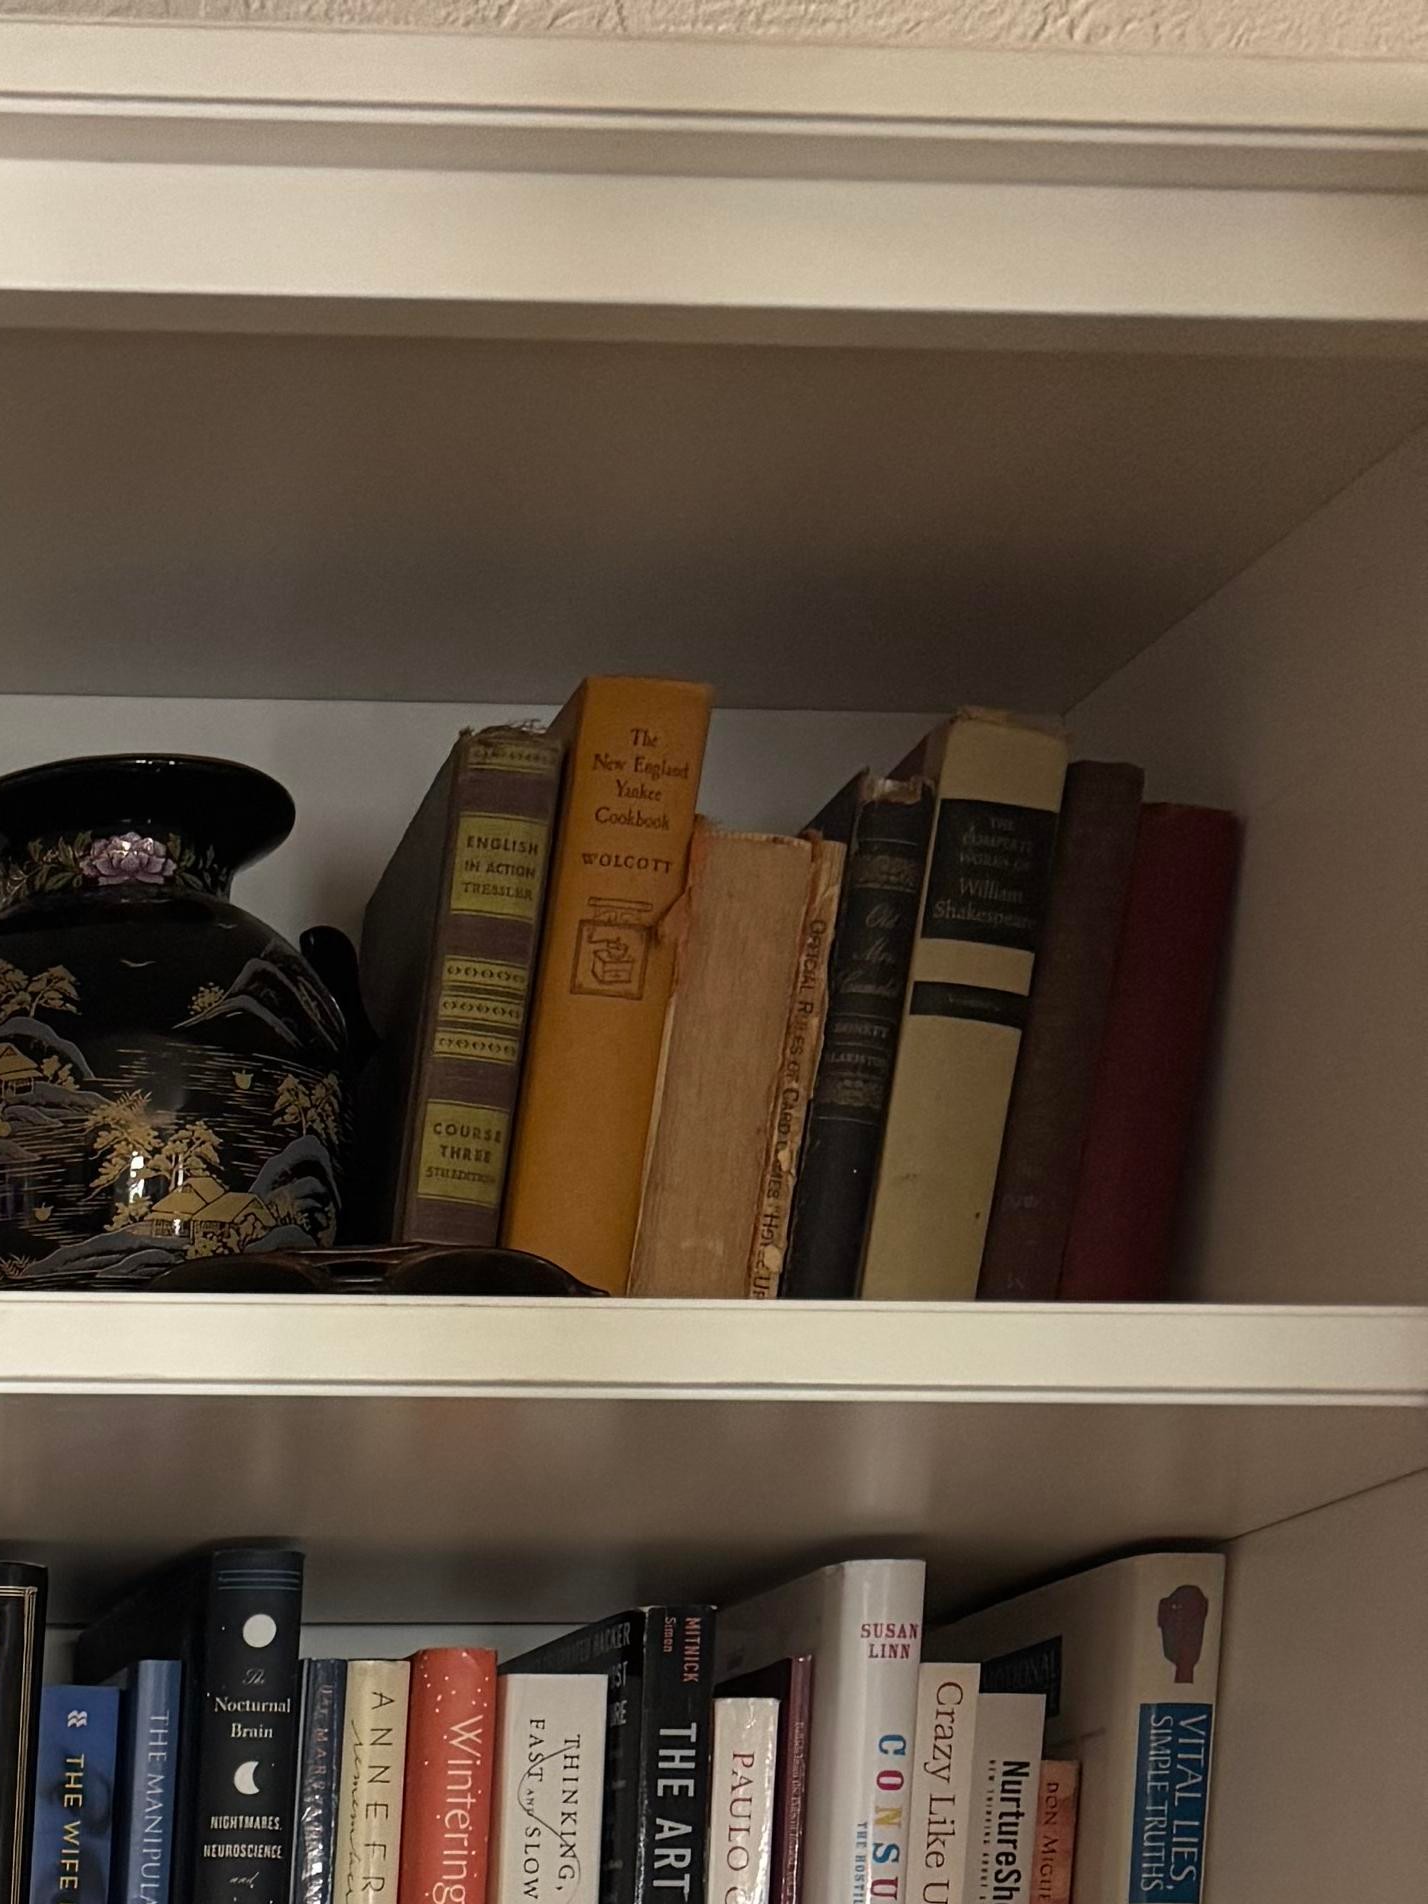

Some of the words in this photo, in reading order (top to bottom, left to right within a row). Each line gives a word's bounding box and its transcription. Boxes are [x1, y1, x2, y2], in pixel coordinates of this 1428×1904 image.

[631, 728, 659, 750] The
[593, 751, 626, 774] New
[633, 757, 690, 781] England
[615, 779, 662, 804] Yankee
[596, 808, 671, 832] Cookbook
[465, 833, 540, 857] ENGLISH
[464, 860, 481, 878] IN
[487, 861, 536, 882] ACTION
[581, 852, 674, 875] WOLCOTT
[432, 1122, 503, 1144] COURSE
[439, 1143, 493, 1164] THREE
[664, 1617, 675, 1654] Simon
[860, 1623, 920, 1640] SUSAN
[683, 1616, 700, 1684] MITNICK
[868, 1642, 911, 1659] LINN
[214, 1697, 292, 1715] Nocturnal
[230, 1723, 274, 1739] Brain
